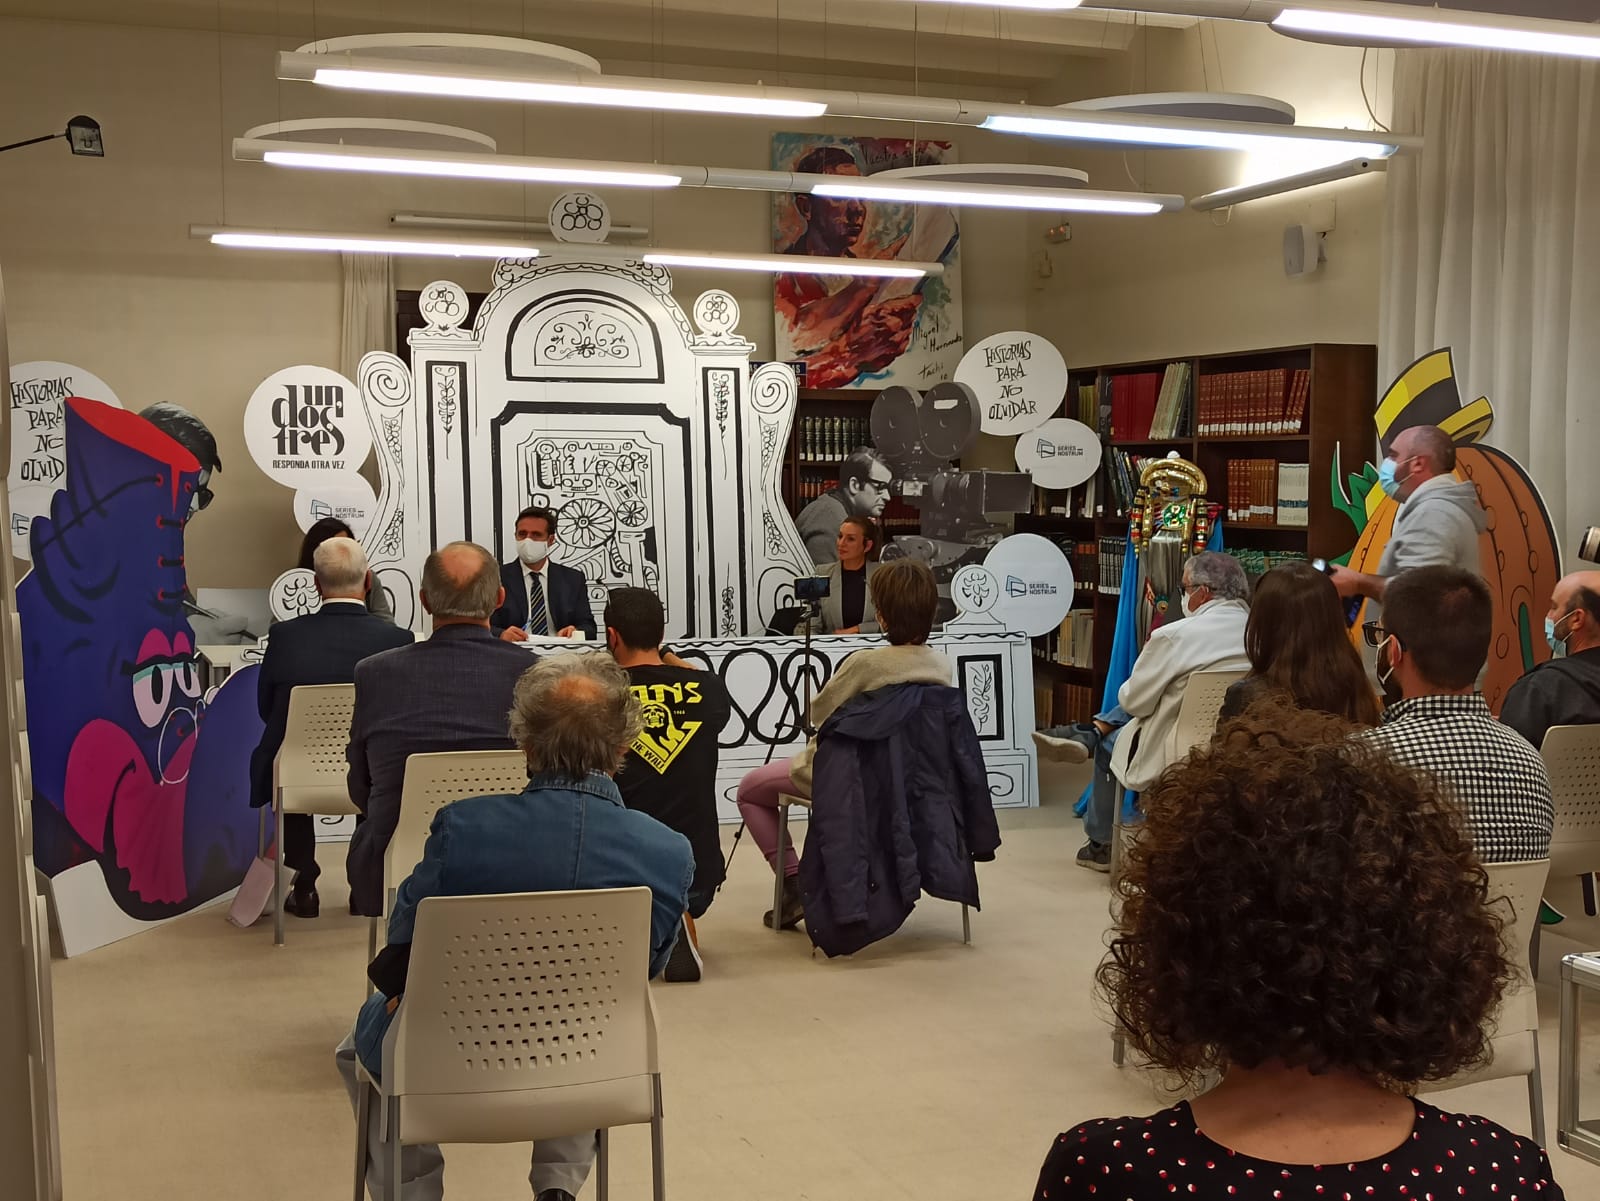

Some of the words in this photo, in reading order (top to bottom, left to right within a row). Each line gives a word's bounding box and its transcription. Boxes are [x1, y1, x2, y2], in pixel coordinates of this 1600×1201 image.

[982, 340, 1032, 368] HISTORIAS
[995, 360, 1027, 383] PARA
[301, 385, 344, 418] un
[999, 385, 1023, 400] NO
[24, 402, 63, 431] PARA
[988, 398, 1038, 422] OLVIDAR
[20, 454, 65, 484] OLVID
[272, 459, 310, 470] RESPONDA
[311, 460, 331, 470] OTRA
[331, 460, 345, 470] VEZ
[629, 681, 703, 704] ANS
